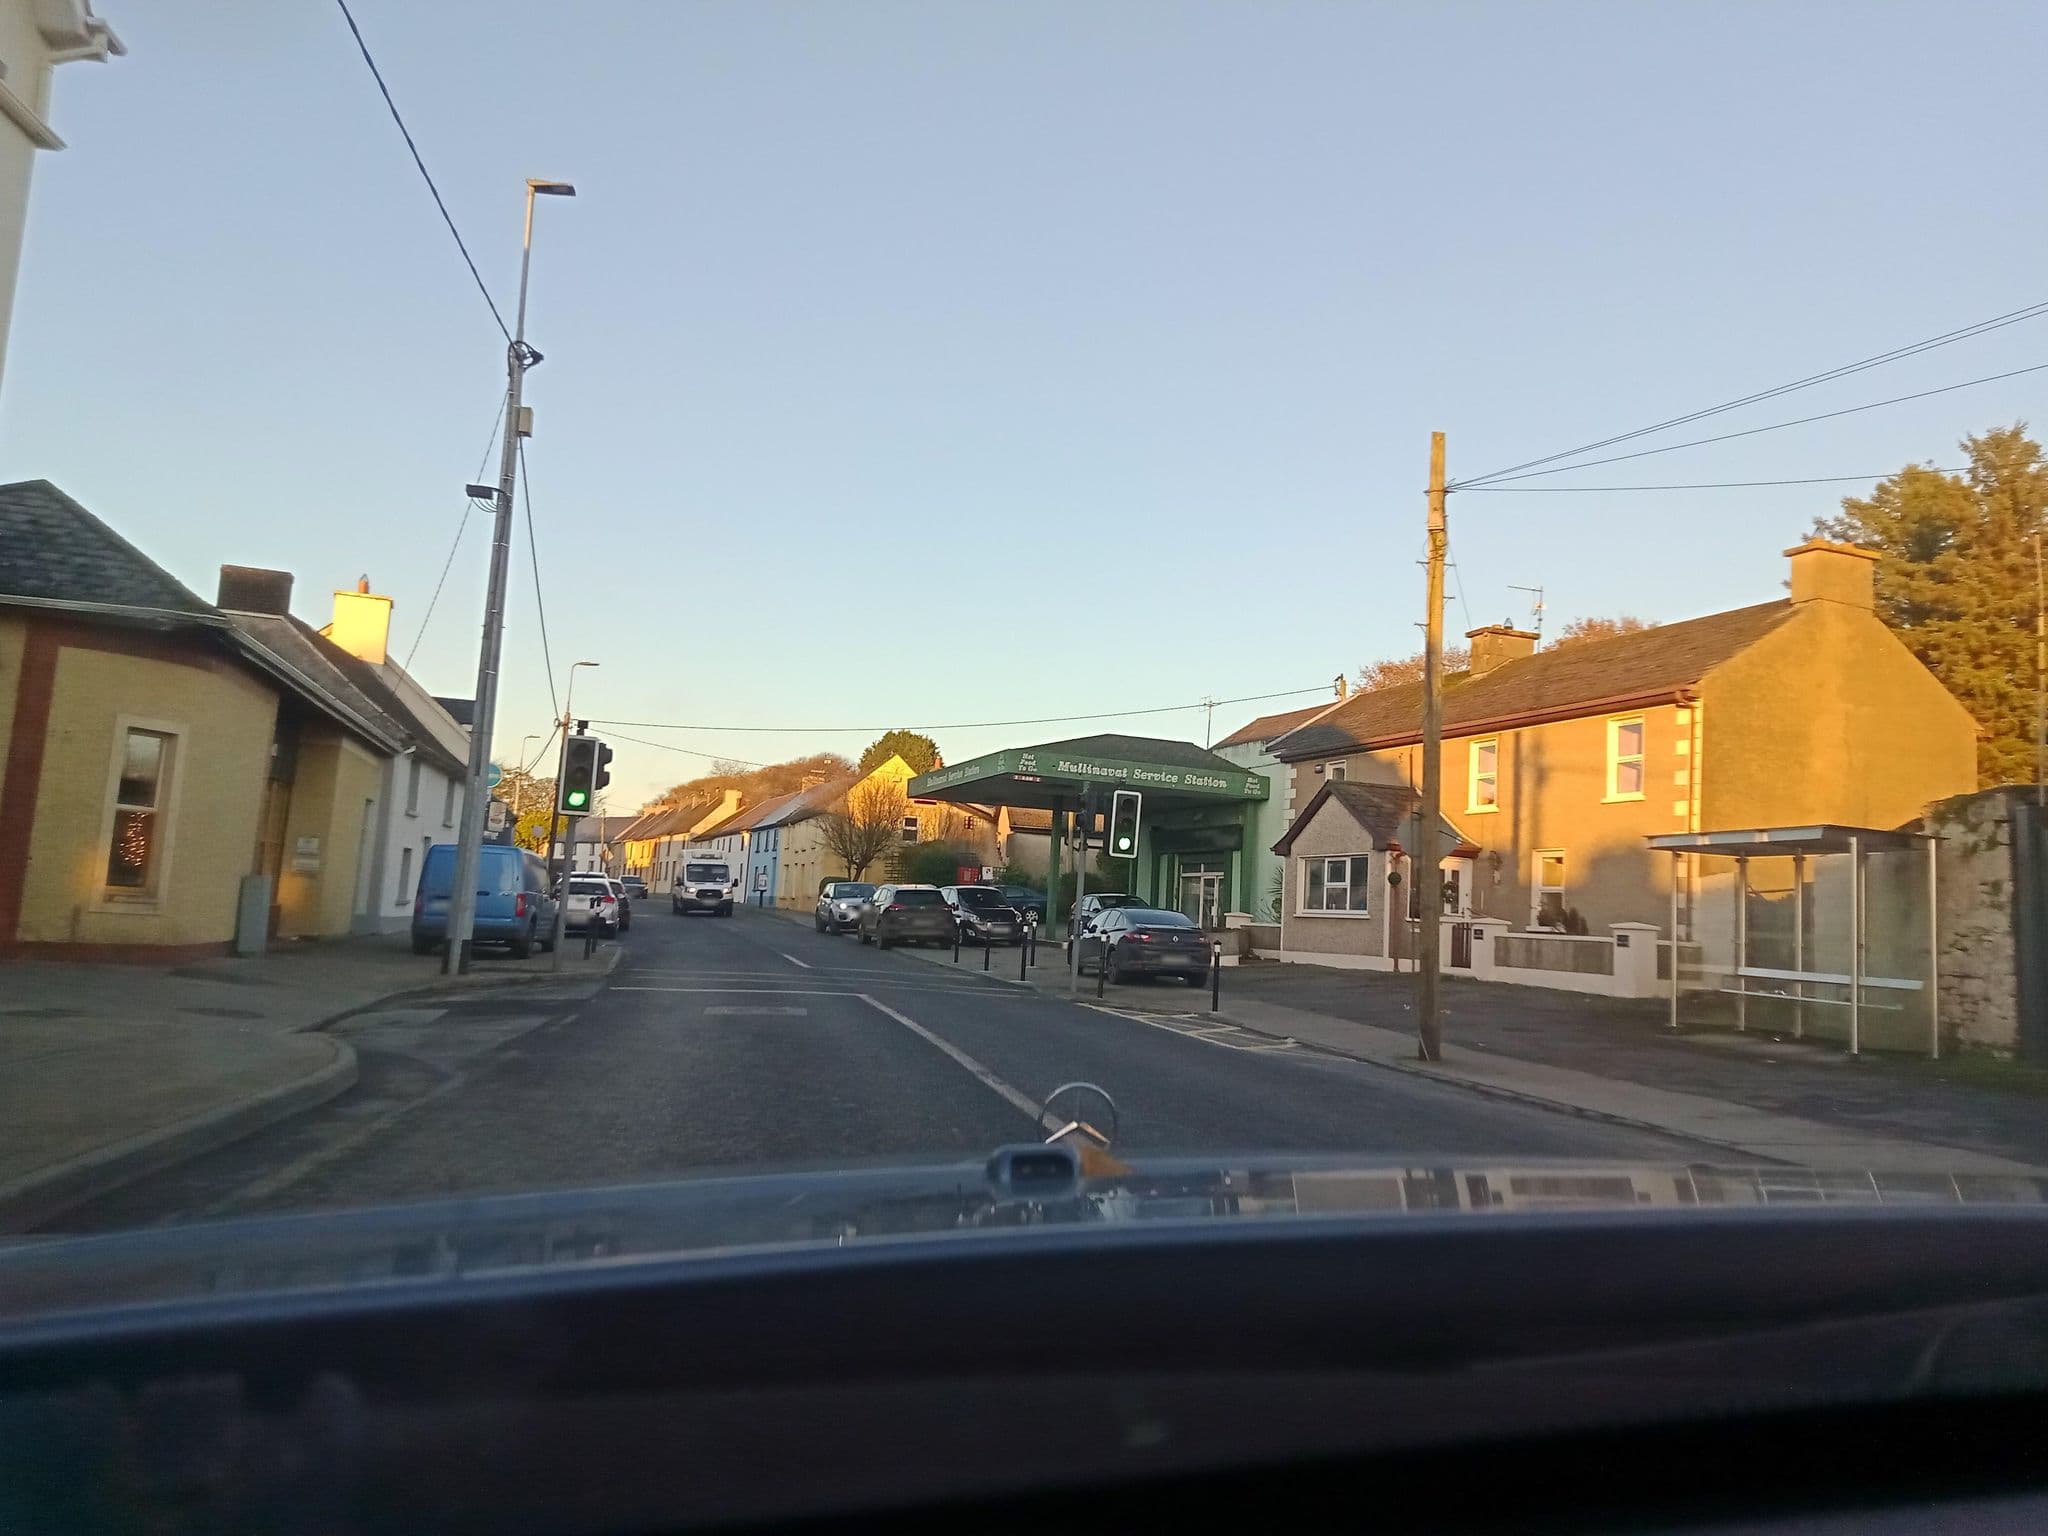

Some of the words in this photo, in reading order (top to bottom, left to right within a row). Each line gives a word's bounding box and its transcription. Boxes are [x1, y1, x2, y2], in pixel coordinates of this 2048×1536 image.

[1057, 761, 1128, 778] Mullinavat
[1133, 769, 1179, 783] Service
[1184, 774, 1228, 789] Station
